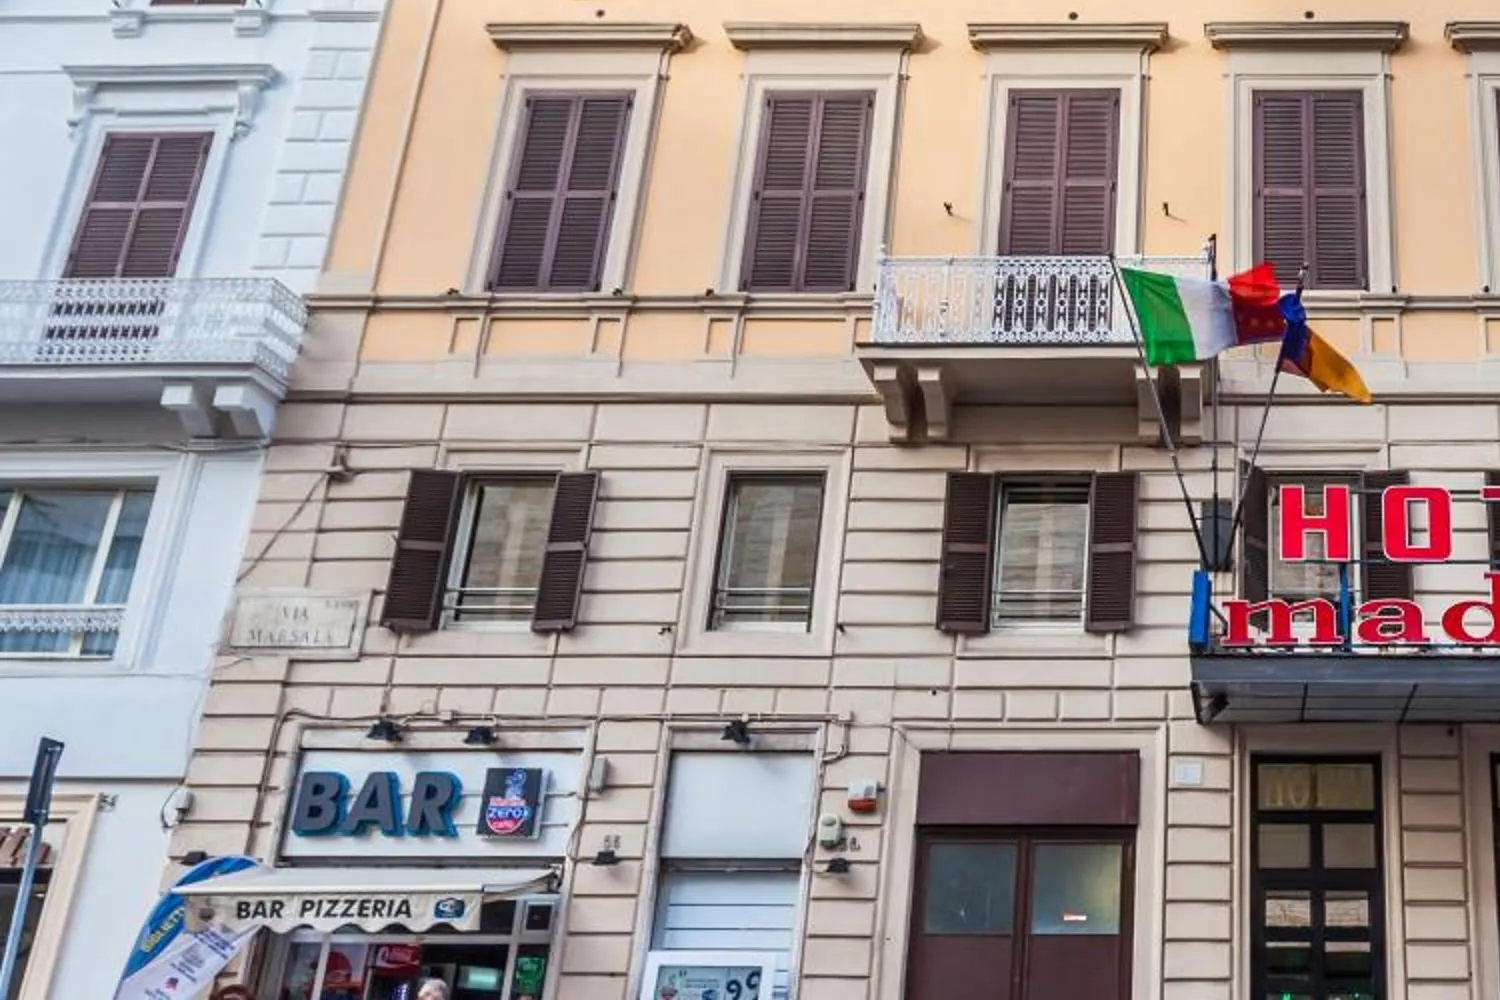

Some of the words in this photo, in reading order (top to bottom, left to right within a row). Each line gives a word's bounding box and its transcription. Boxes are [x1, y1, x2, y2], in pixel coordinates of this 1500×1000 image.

[292, 771, 463, 837] BAR
[236, 899, 284, 920] BAR
[299, 898, 412, 919] PIZZERIA
